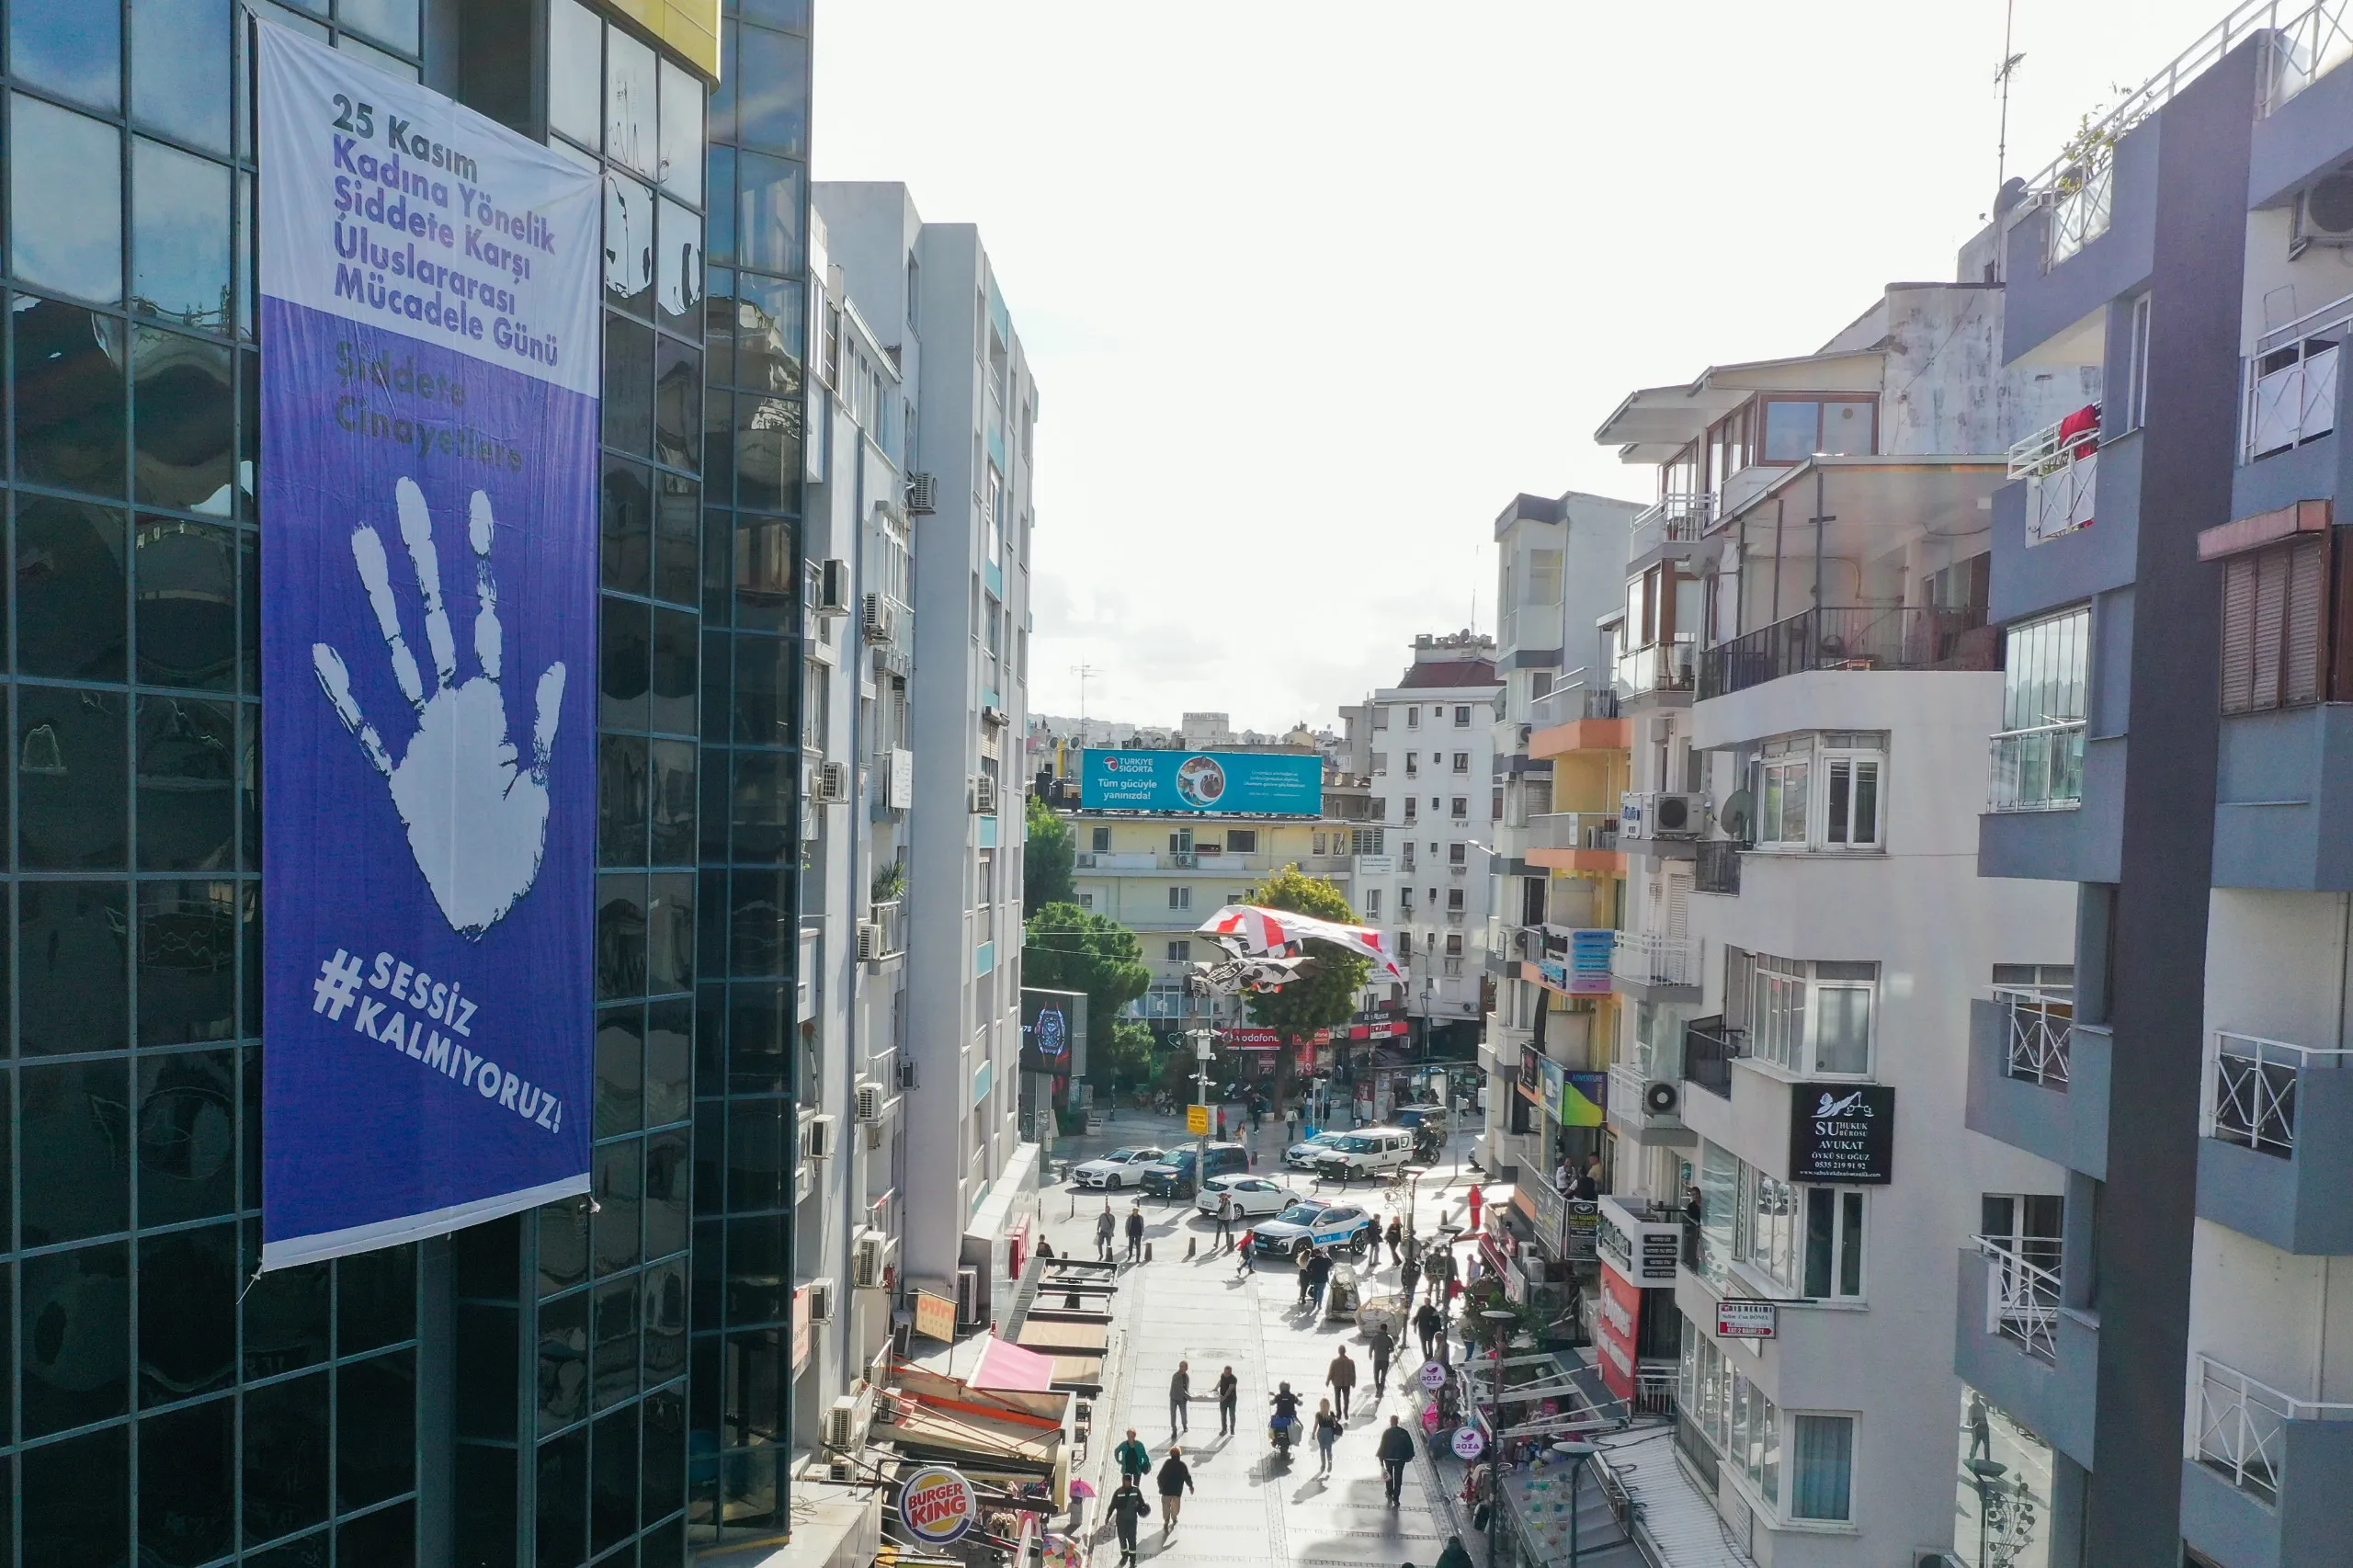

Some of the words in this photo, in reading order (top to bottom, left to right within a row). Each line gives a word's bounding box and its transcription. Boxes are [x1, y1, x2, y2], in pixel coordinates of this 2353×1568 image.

[332, 93, 374, 139] 25
[388, 115, 478, 183] Kasım
[333, 134, 449, 209] Kadına
[459, 182, 556, 255] Yönelik
[333, 175, 455, 249] Şiddete
[464, 225, 530, 285] Karşı
[334, 221, 516, 314] Uluslararası
[334, 263, 484, 341] Mücadele
[493, 318, 559, 367] Günü
[1097, 778, 1119, 788] Tüm
[1120, 779, 1157, 790] gücüyle
[1103, 791, 1151, 801] yanınızda!
[354, 995, 562, 1134] KALMIYORUZ!
[1815, 1121, 1839, 1136] SU
[1819, 1141, 1864, 1150] AVUKAT
[908, 1483, 963, 1510] BURGER
[911, 1495, 967, 1528] KING
